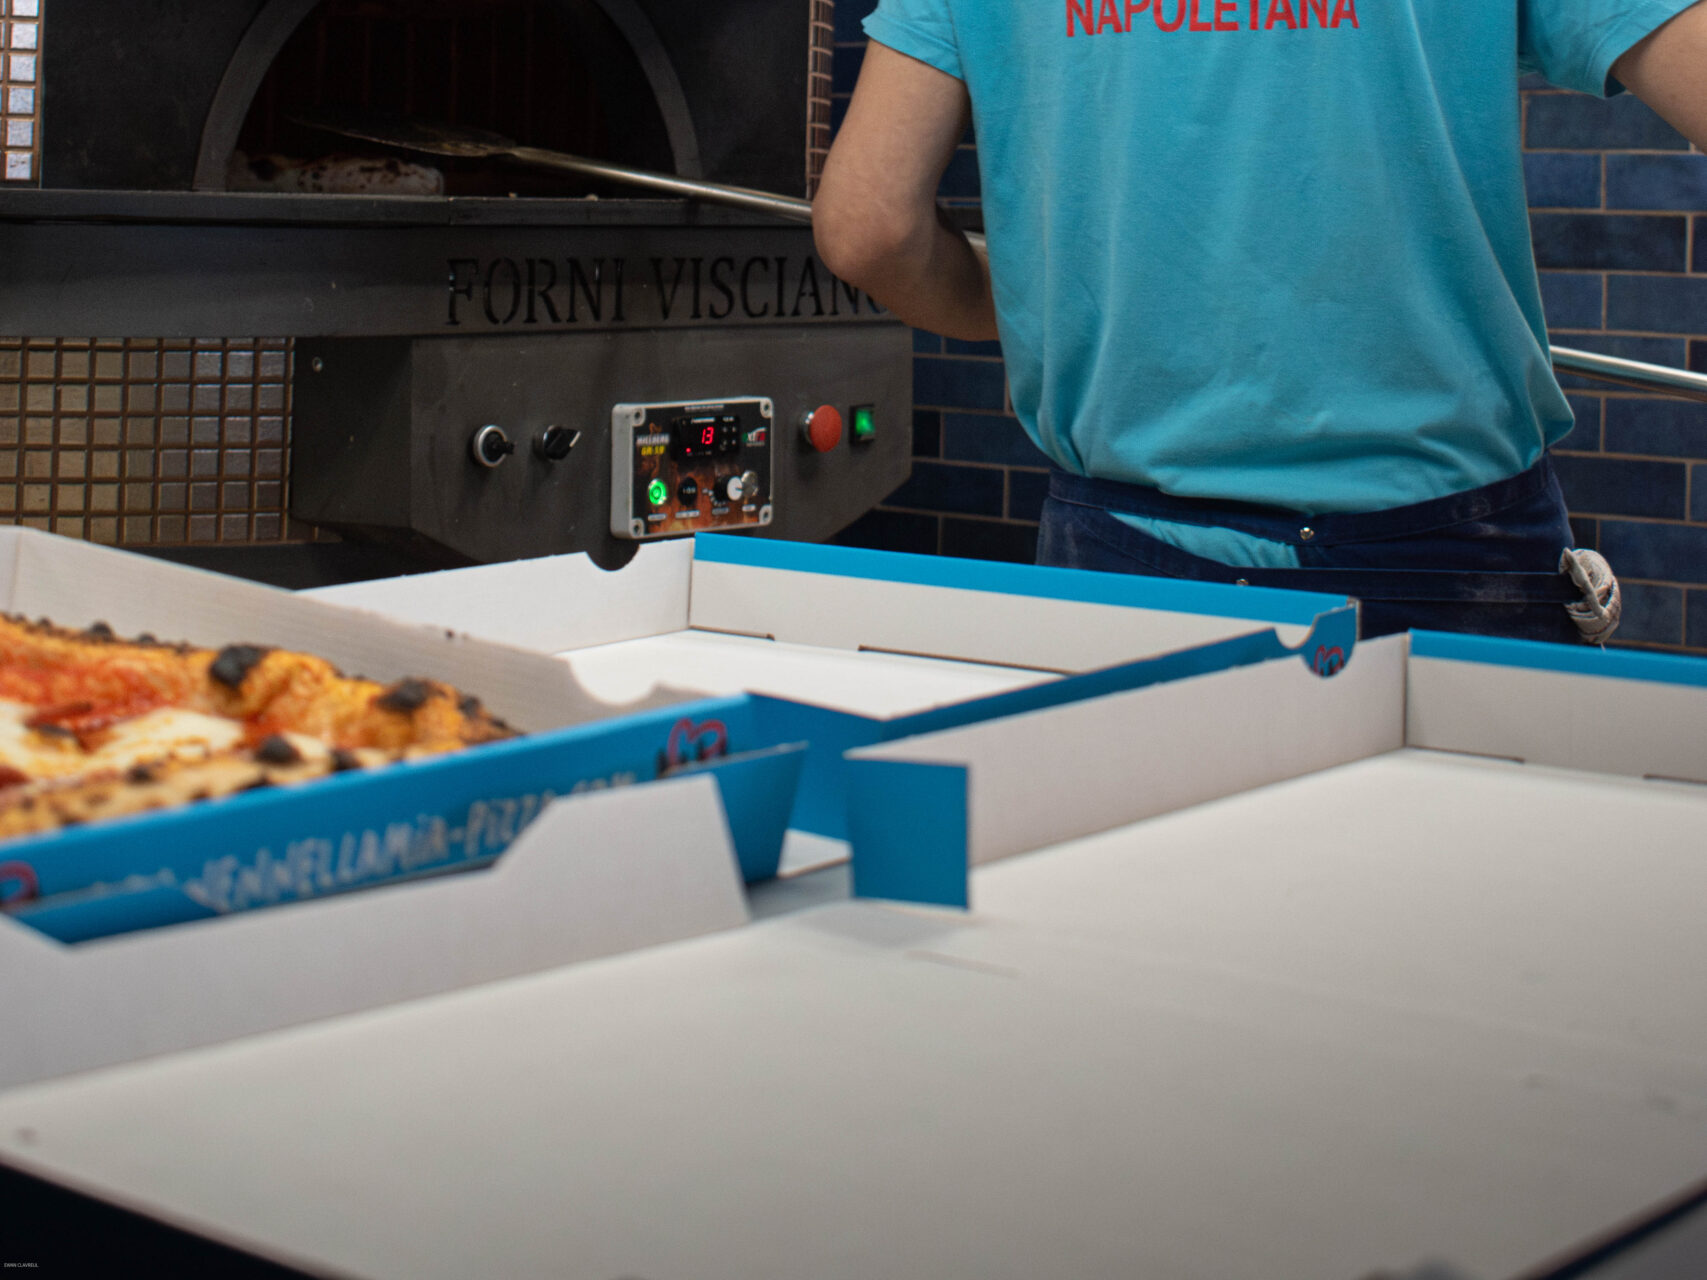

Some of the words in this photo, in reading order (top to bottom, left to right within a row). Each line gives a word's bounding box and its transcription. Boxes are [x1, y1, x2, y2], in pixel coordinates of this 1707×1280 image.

[446, 256, 627, 325] FORNI
[648, 254, 890, 320] VISCIAN
[701, 426, 715, 445] 13
